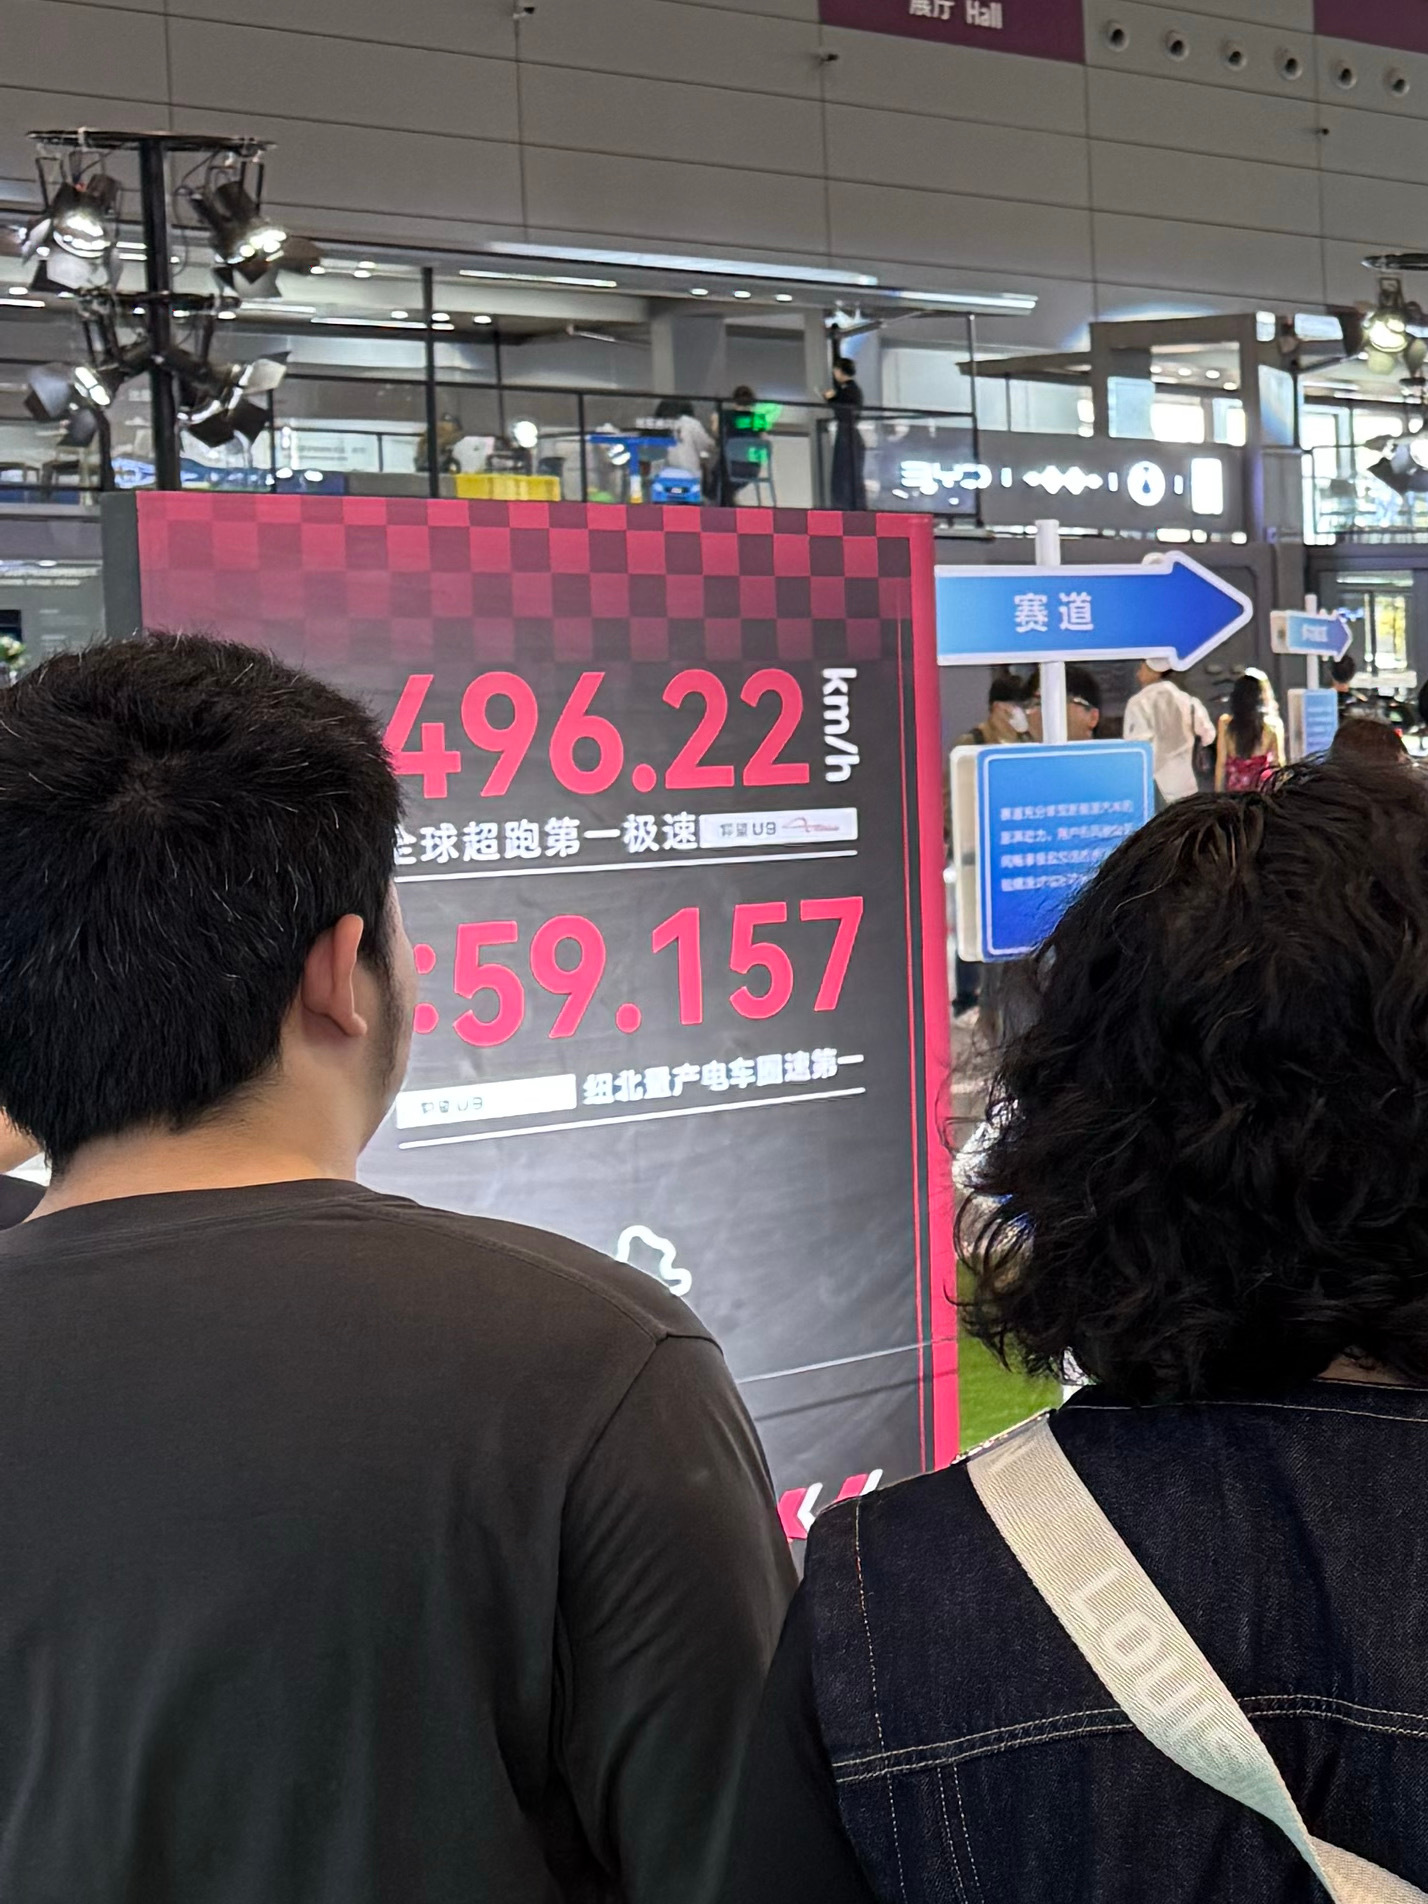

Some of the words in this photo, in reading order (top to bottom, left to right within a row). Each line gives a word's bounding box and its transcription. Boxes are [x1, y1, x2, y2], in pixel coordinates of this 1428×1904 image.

[1012, 590, 1095, 633] 赛道
[382, 667, 811, 799] 496.22
[822, 667, 861, 783] km/h
